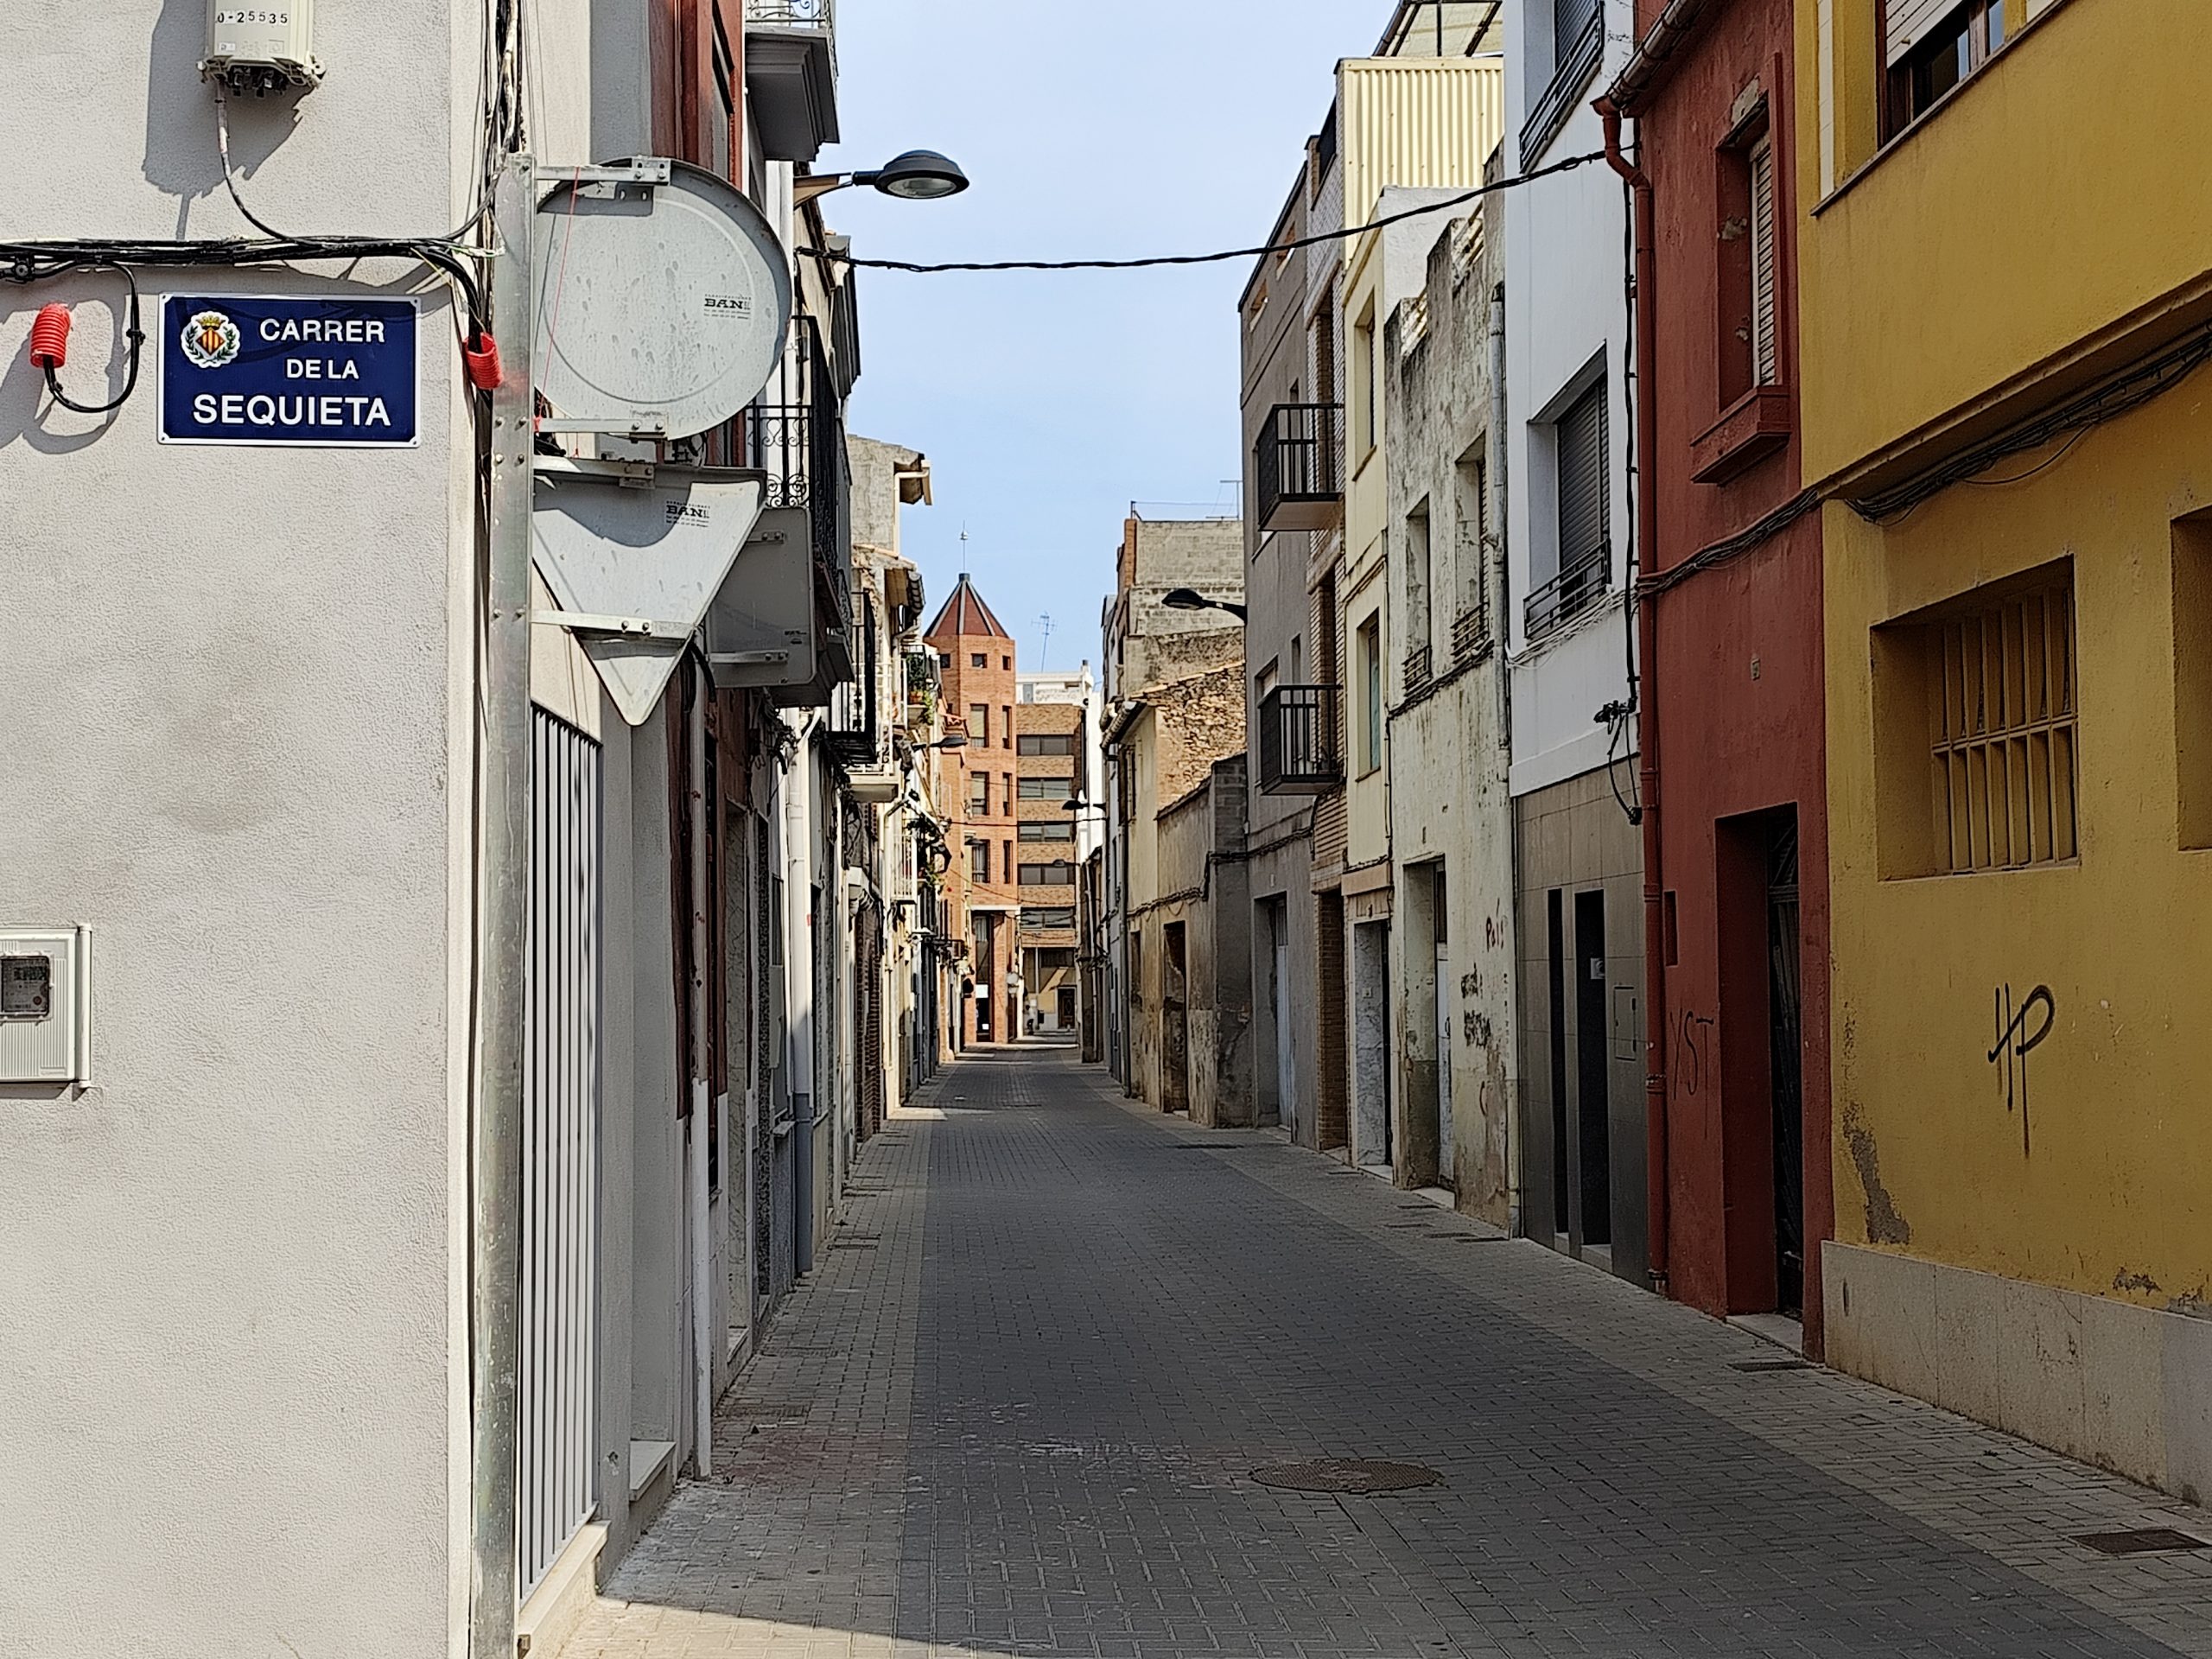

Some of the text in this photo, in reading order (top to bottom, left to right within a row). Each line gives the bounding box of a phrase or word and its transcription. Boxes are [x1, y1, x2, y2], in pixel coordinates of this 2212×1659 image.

[259, 317, 385, 343] CARRER
[286, 359, 359, 379] DE LA
[192, 393, 391, 426] SEQUIETA
